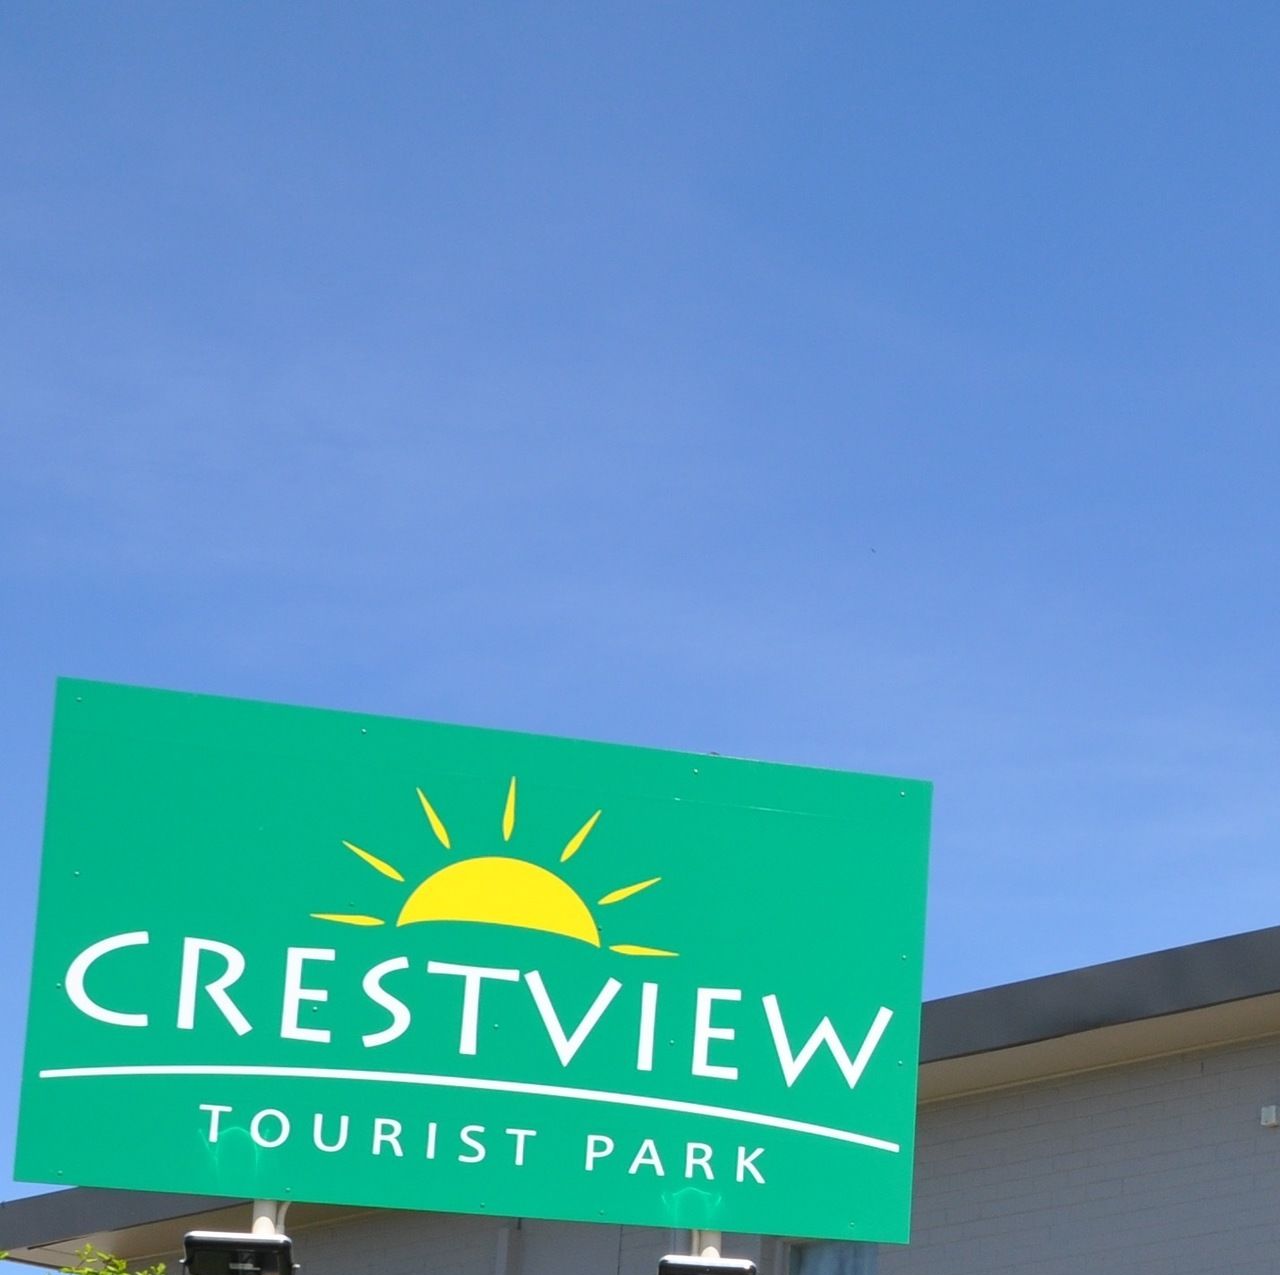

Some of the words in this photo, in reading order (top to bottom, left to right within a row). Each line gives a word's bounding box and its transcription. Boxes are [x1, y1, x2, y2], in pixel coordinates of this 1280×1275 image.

[65, 931, 894, 1089] CRESTVIEW
[199, 1104, 537, 1168] TOURIST
[585, 1134, 767, 1185] PARK
